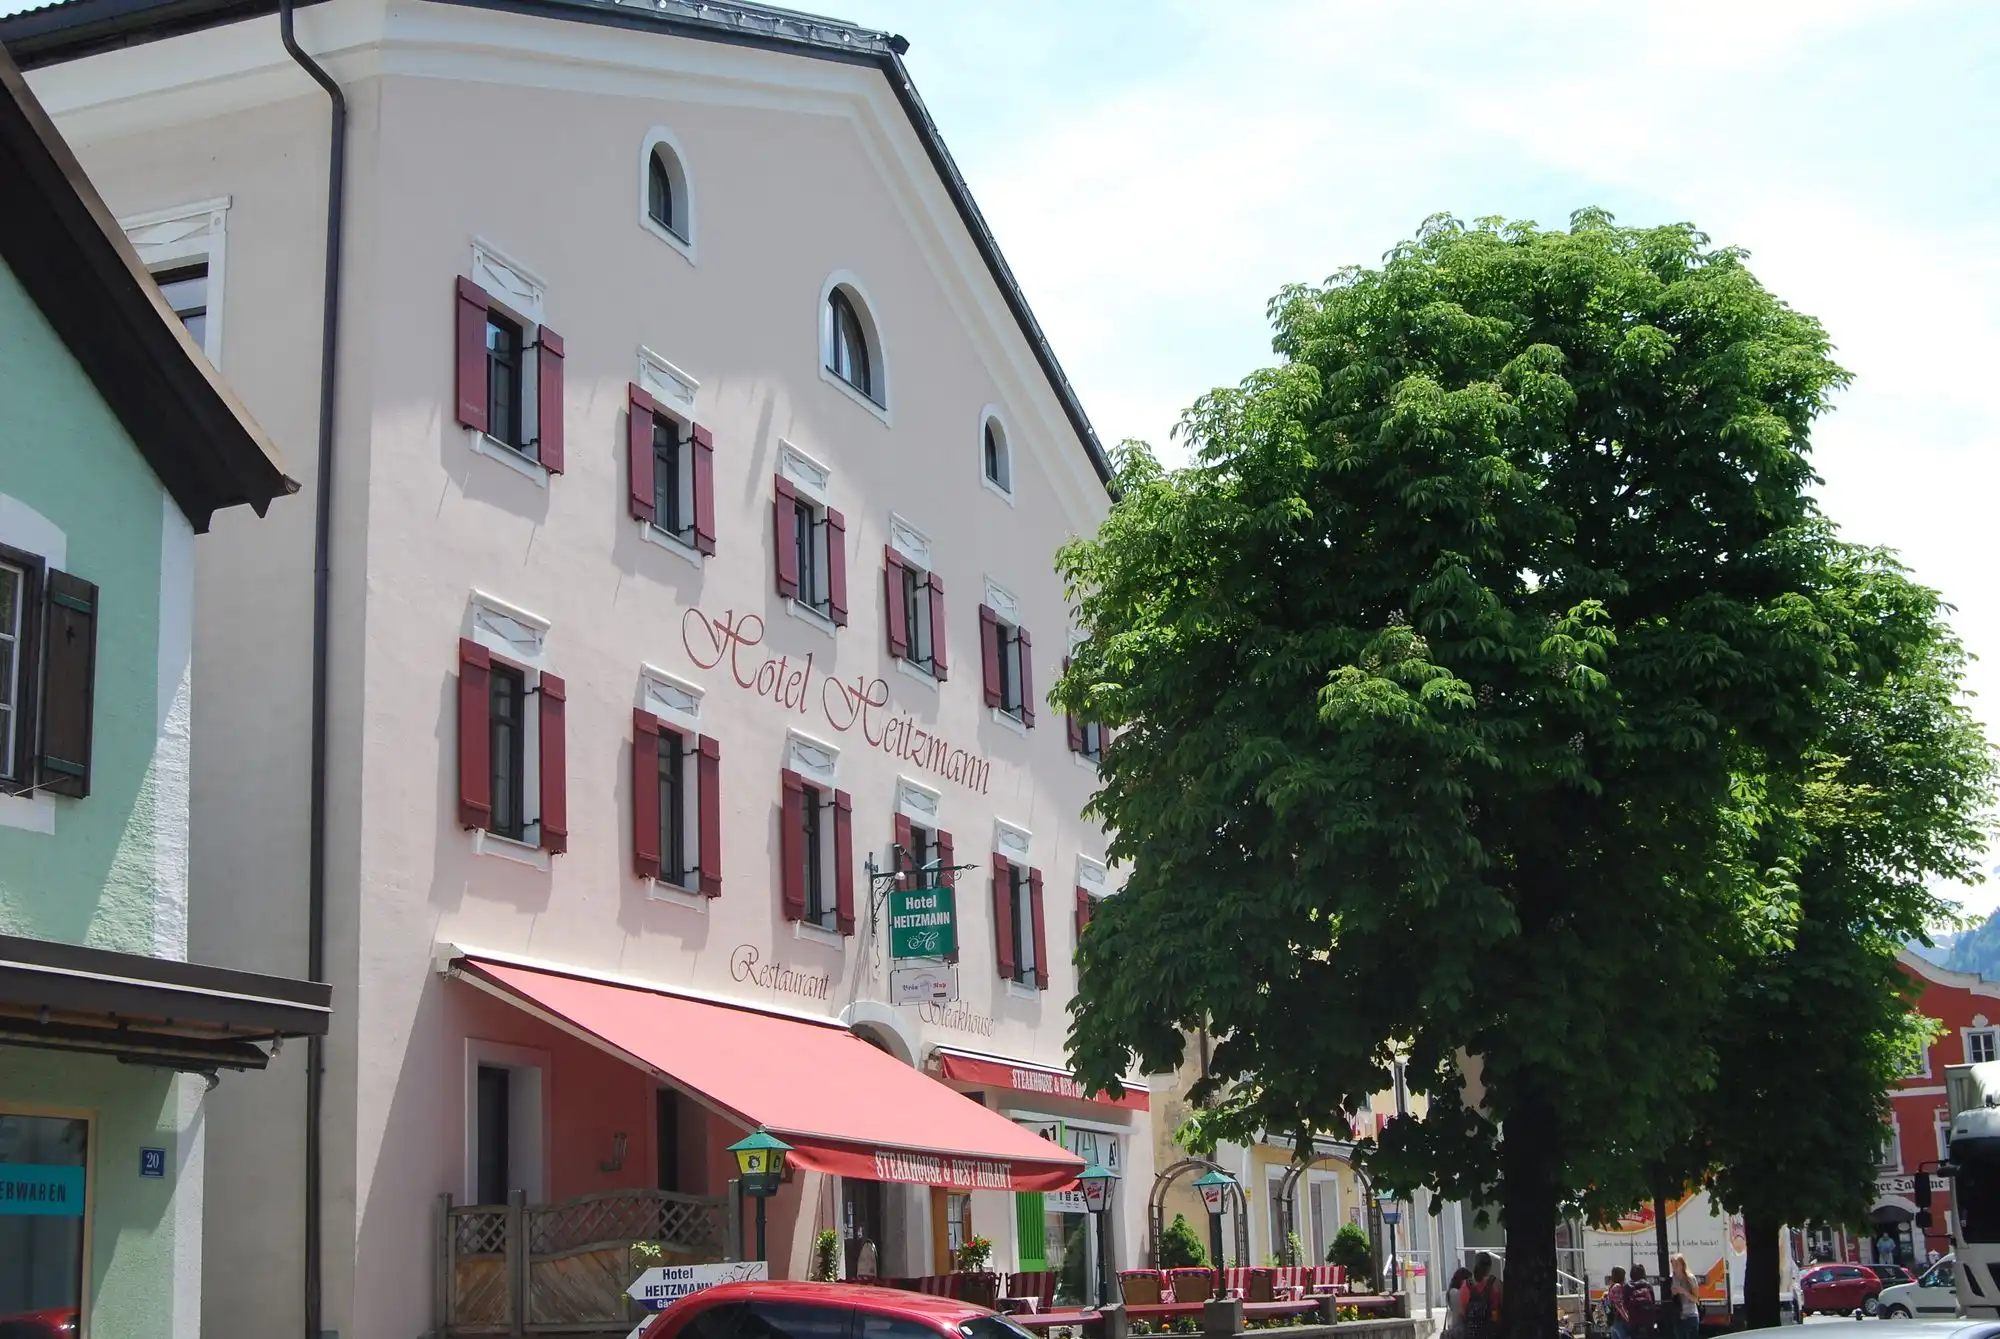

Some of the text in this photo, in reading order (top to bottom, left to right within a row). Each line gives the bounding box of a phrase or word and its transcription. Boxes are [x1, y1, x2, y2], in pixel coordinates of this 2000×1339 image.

[682, 608, 990, 795] Hotel Heitzmann
[905, 895, 937, 910] Hotel
[894, 912, 951, 929] HEITZMANN
[730, 944, 829, 1000] Restaurant
[918, 1000, 994, 1037] Steakhouse
[1012, 1069, 1053, 1093] STEAKHOUSE
[1054, 1076, 1060, 1092] &
[146, 1152, 160, 1168] 20
[875, 1150, 1011, 1188] STEAKHOUSE & RESTAURANT
[662, 1268, 693, 1280] Hotel
